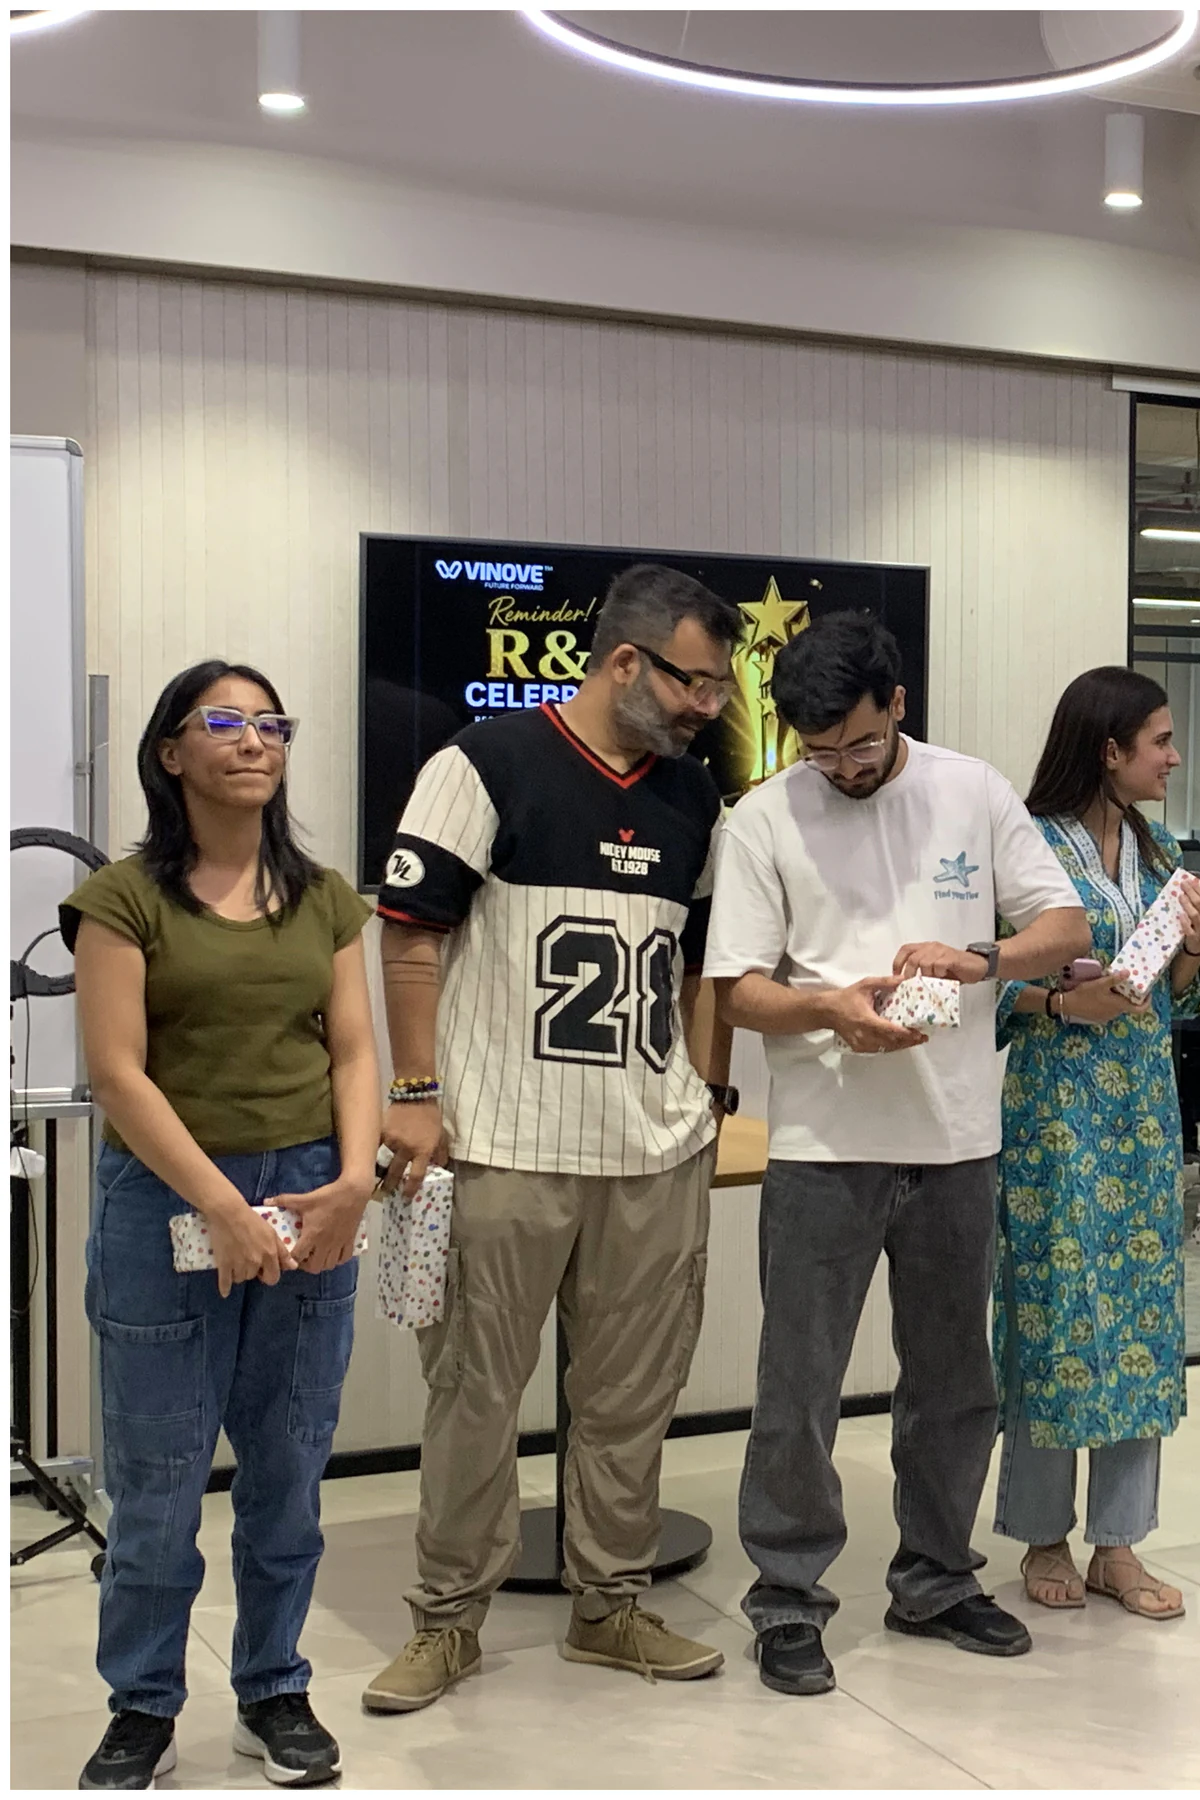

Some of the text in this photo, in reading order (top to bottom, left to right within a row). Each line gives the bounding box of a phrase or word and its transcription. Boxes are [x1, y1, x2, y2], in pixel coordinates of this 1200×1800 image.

[484, 582, 544, 591] FUTURE FORWARD
[488, 596, 597, 626] Reminder!
[628, 846, 661, 863] MOUSE
